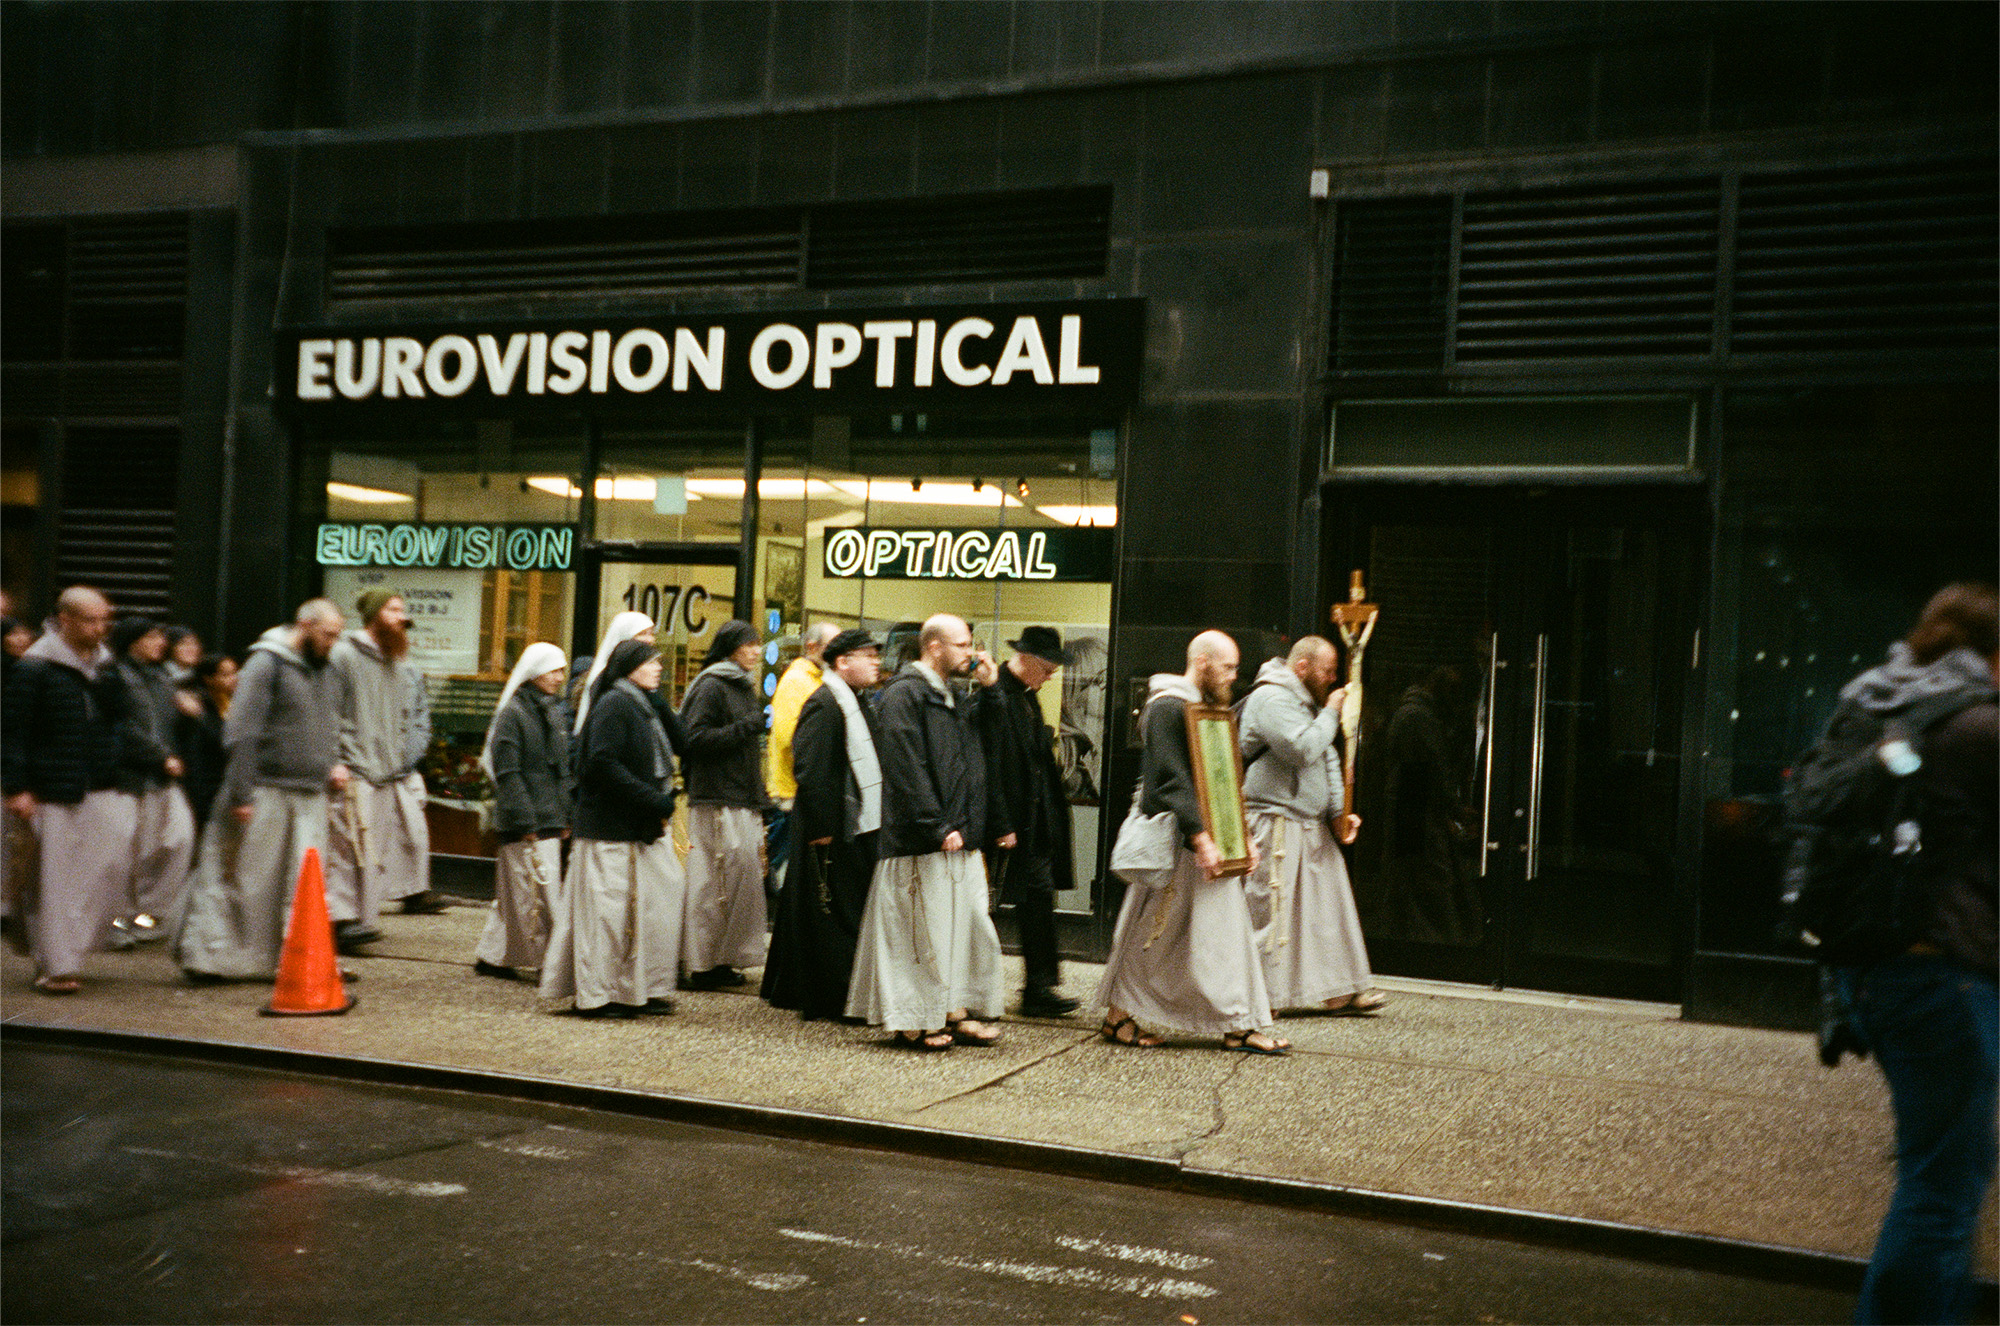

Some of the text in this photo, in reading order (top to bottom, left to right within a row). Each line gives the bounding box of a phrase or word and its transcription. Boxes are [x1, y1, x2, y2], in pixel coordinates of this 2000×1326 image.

[297, 315, 1101, 399] EUROVISION OPTICAL
[316, 523, 573, 570] EUROVISION
[825, 529, 1057, 579] OPTICAL
[623, 583, 710, 637] 107C
